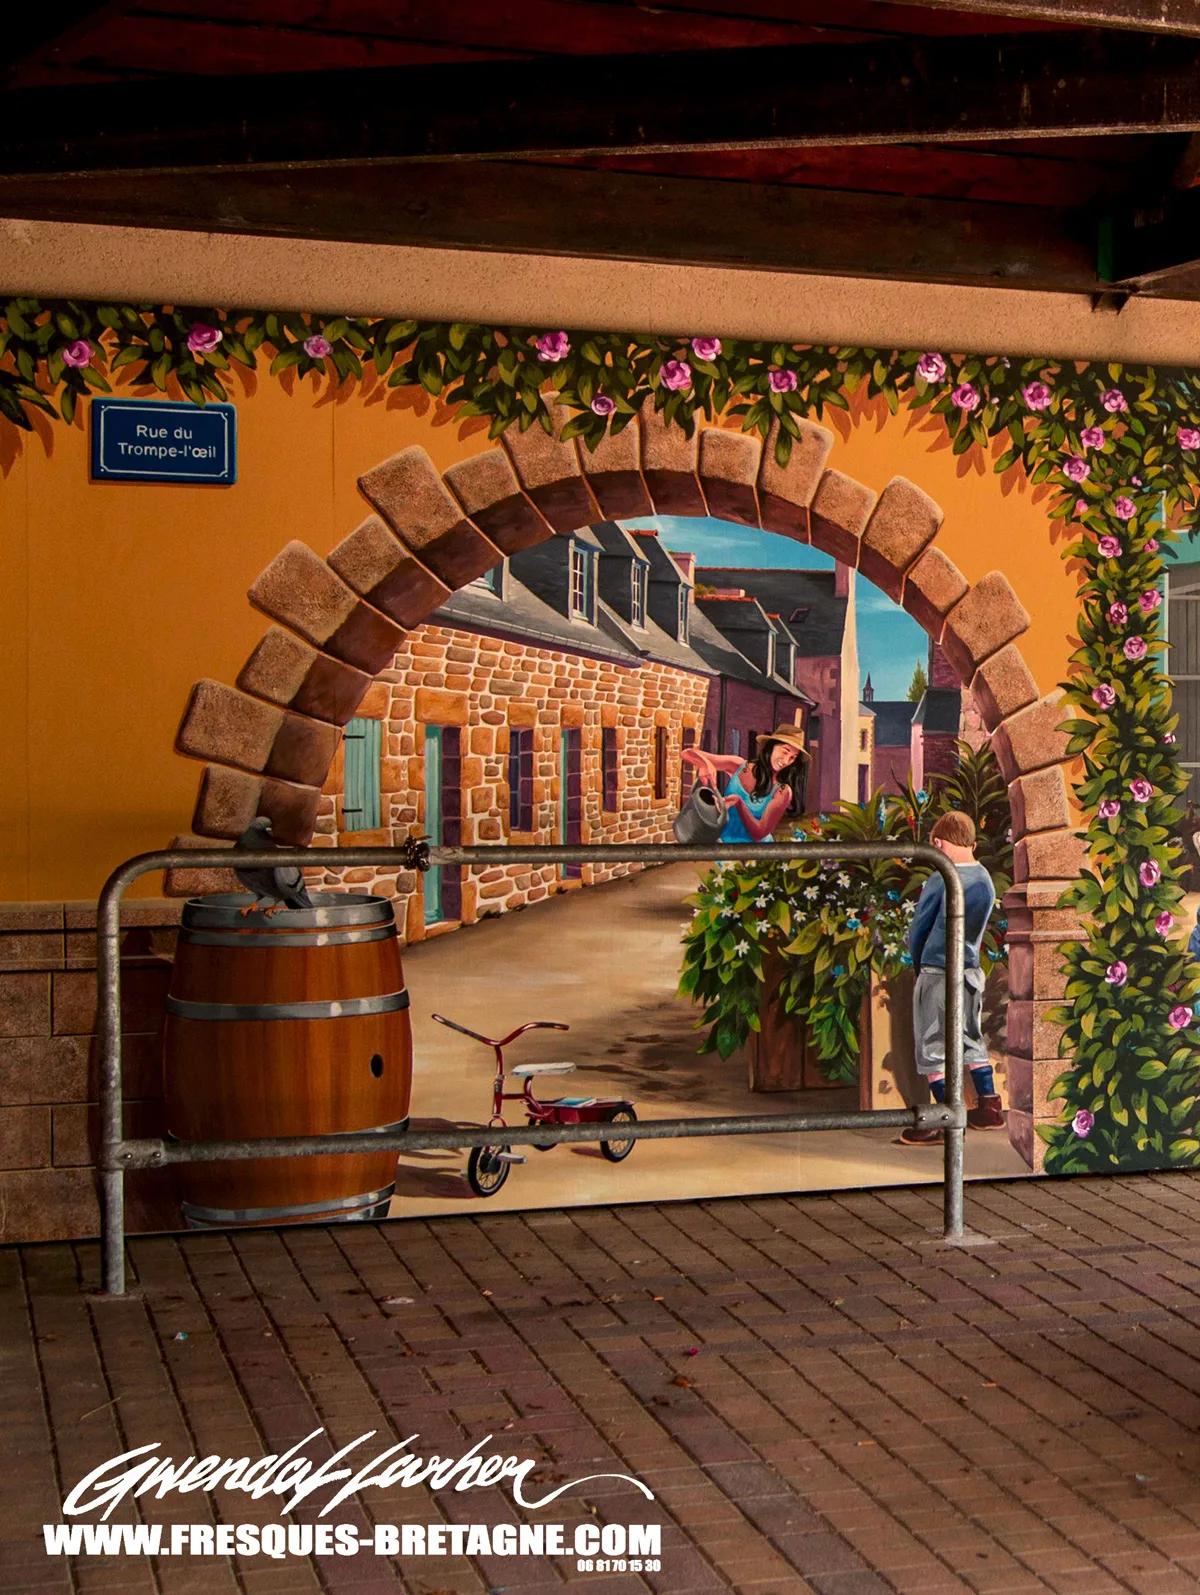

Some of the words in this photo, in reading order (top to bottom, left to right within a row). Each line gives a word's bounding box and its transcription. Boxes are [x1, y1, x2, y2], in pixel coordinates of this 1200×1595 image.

[136, 425, 168, 438] Rue
[173, 427, 193, 439] du
[118, 442, 217, 459] Trompe-l'œil
